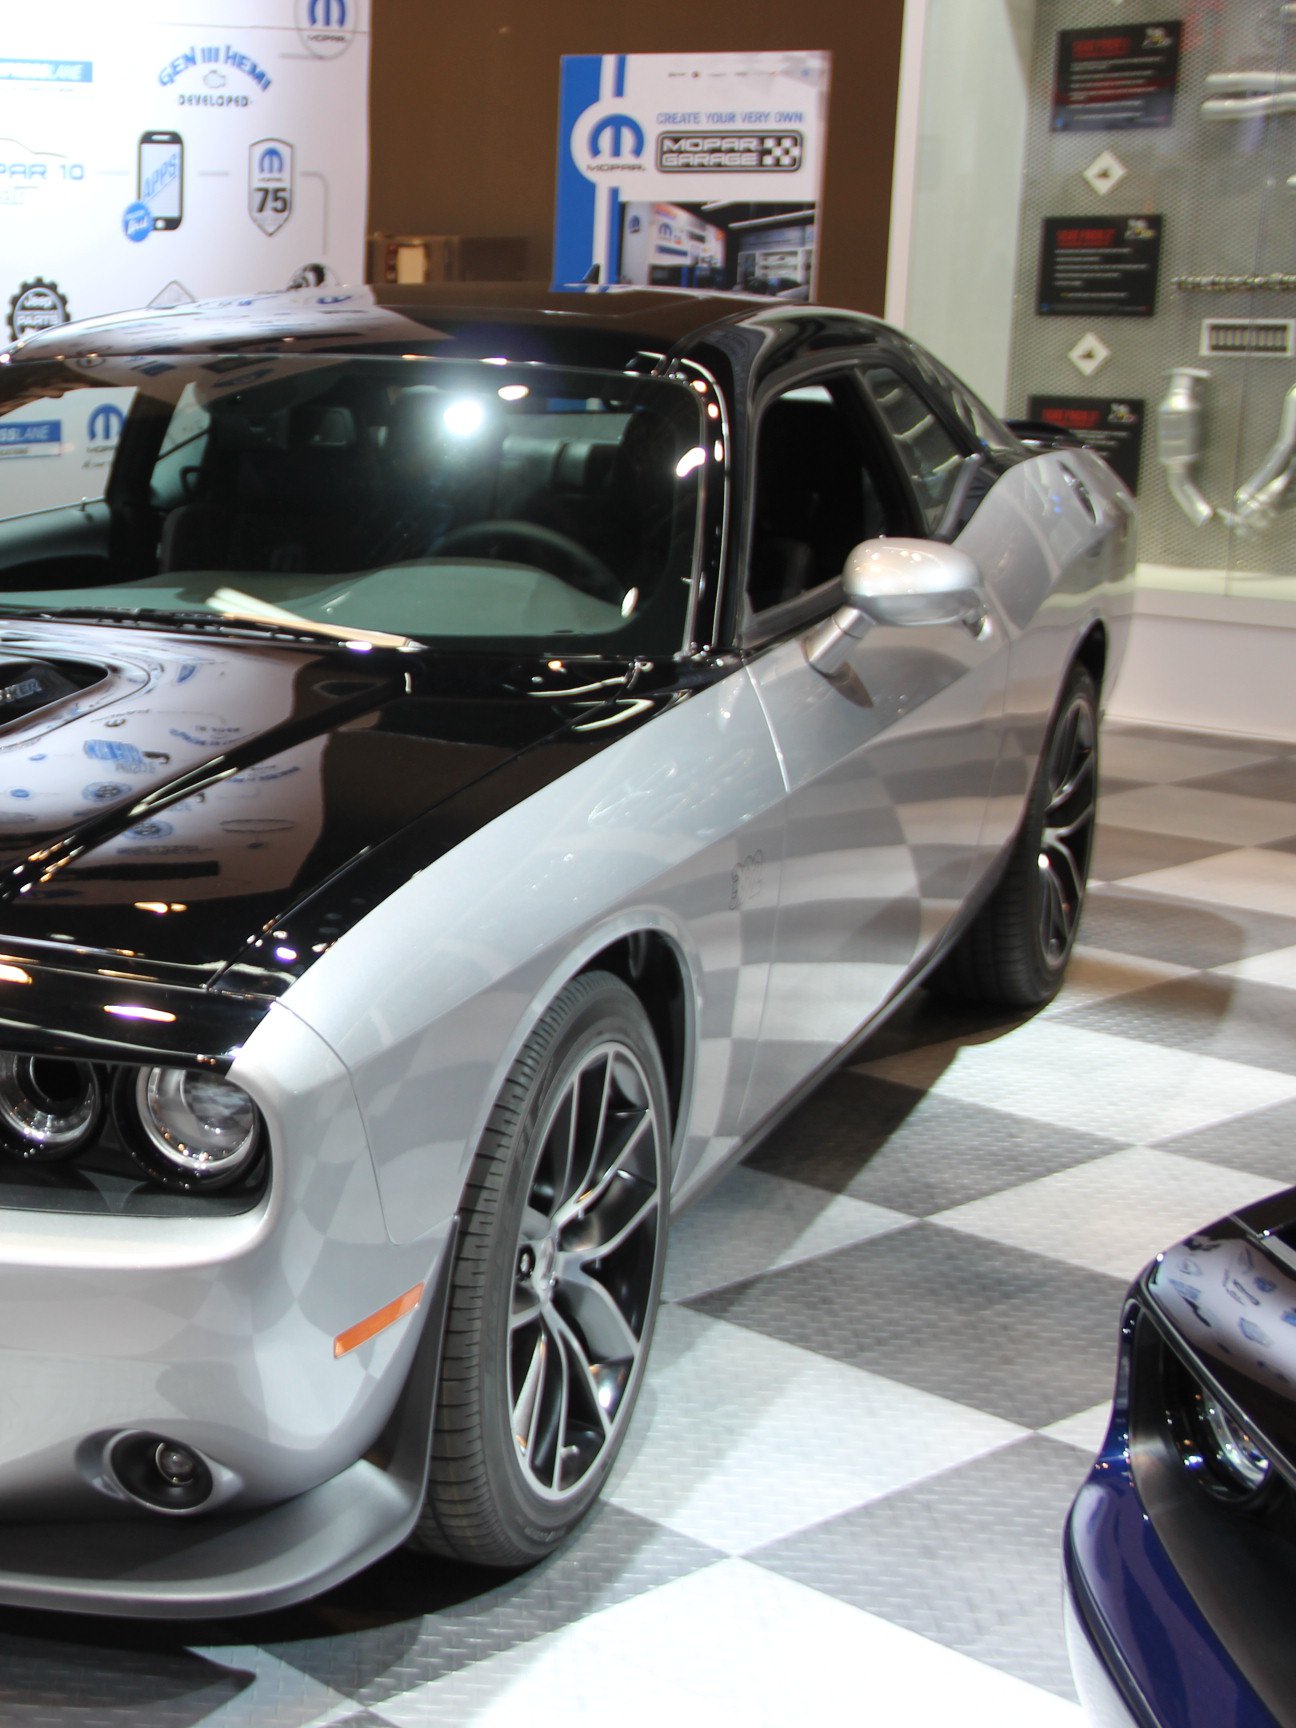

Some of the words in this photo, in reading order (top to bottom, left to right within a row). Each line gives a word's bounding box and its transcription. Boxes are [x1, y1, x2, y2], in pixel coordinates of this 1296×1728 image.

[158, 46, 197, 87] GEN
[201, 47, 220, 63] III
[224, 45, 272, 91] HEMI
[178, 95, 250, 107] DEVELOPED
[657, 112, 701, 124] CREATE
[705, 112, 736, 124] YOUR
[741, 111, 771, 124] VERY
[775, 111, 803, 123] OWN
[663, 138, 756, 151] MOPAR
[662, 152, 758, 166] GARAGE
[60, 164, 84, 180] 10
[142, 152, 178, 198] APPS
[255, 187, 288, 213] 75
[24, 292, 52, 307] Jeep
